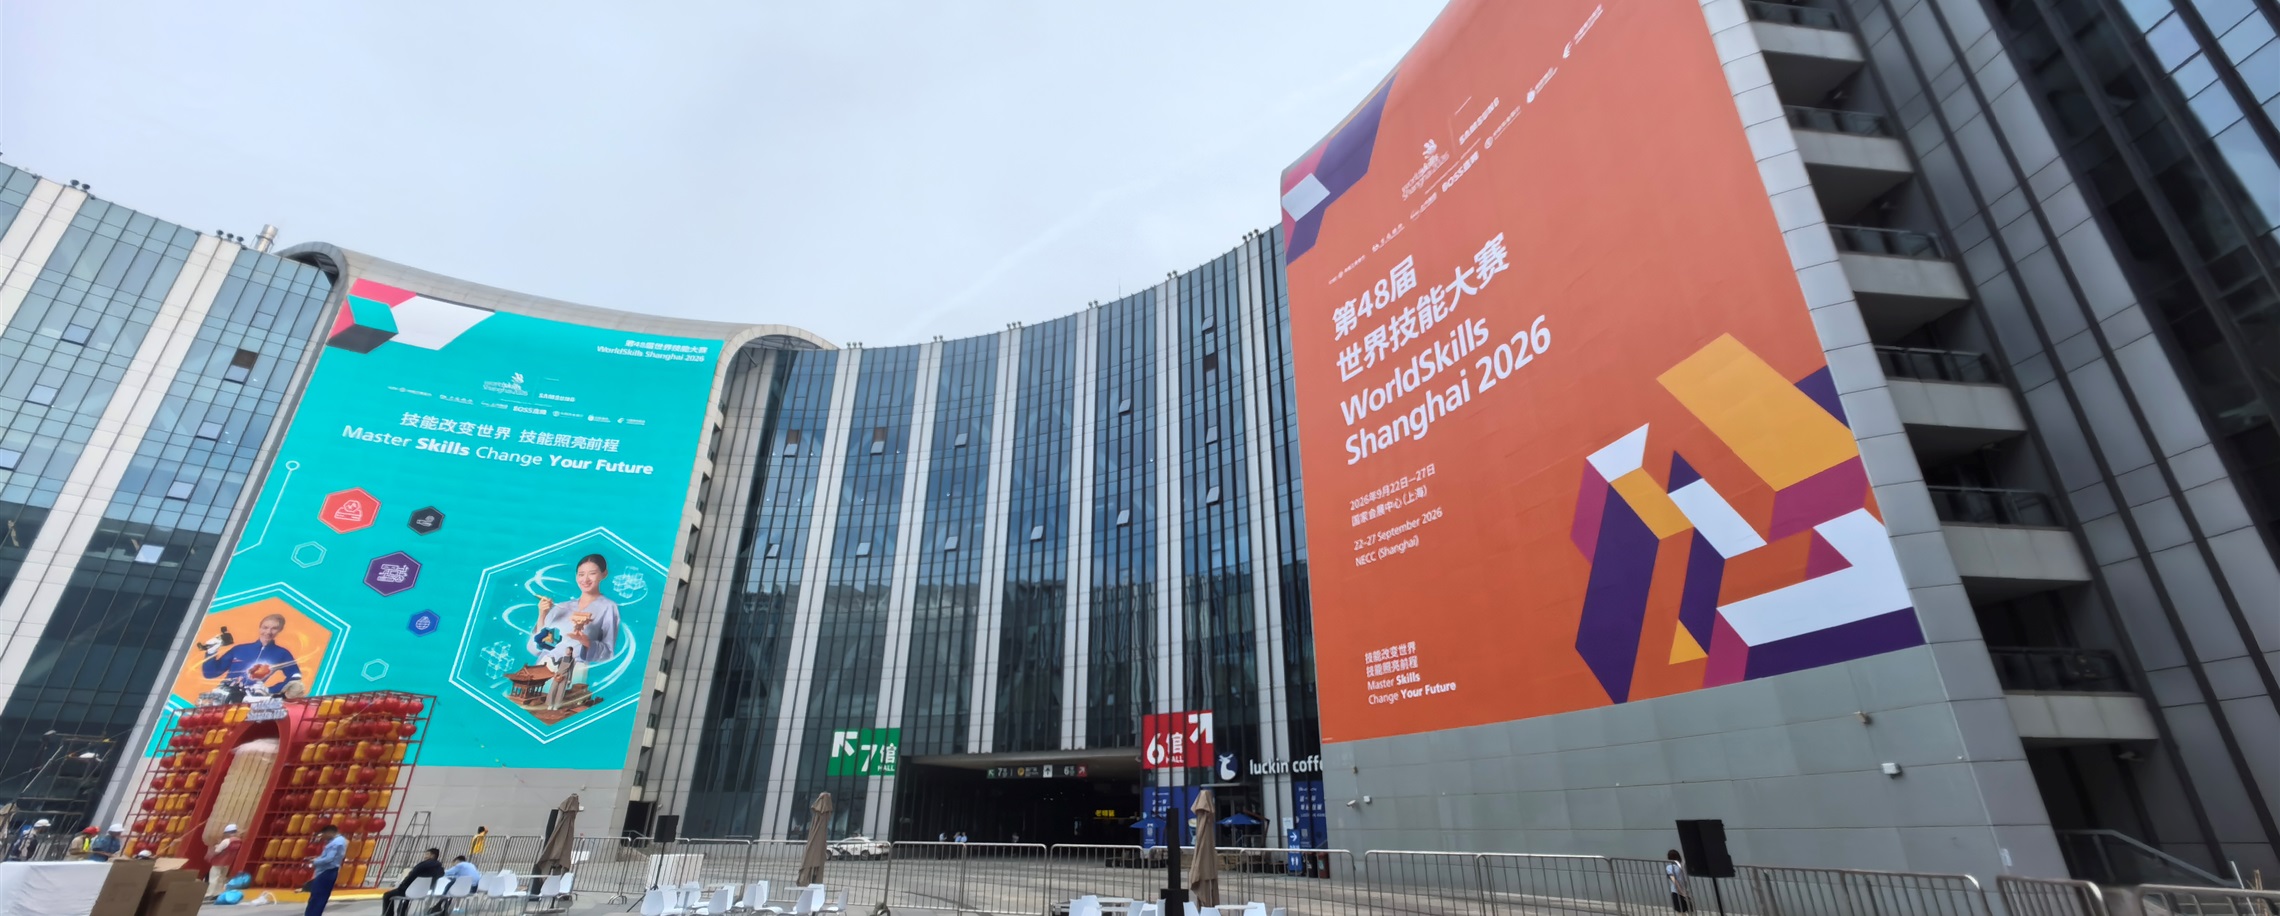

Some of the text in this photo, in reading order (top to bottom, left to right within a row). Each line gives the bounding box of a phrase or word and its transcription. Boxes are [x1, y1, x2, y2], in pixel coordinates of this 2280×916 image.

[1332, 255, 1417, 341] 第48届
[1336, 232, 1509, 383] 世界技能大赛
[597, 346, 643, 357] WorldSkills
[645, 350, 684, 361] Shanghai
[1340, 318, 1489, 426] WorldSkills
[1345, 314, 1551, 466] Shanghai 2026
[400, 411, 620, 452] 技能改变世界 技能照亮前程
[342, 425, 654, 476] Master Skills Change Your Future
[1377, 518, 1420, 542] September
[1422, 506, 1443, 524] 2026
[1355, 534, 1420, 567] NECC (Shanghai)
[1365, 641, 1416, 664] 技能改变世界
[1367, 672, 1420, 691] Master Skills
[1368, 682, 1456, 705] Change Your Future
[1249, 758, 1289, 776] luckin
